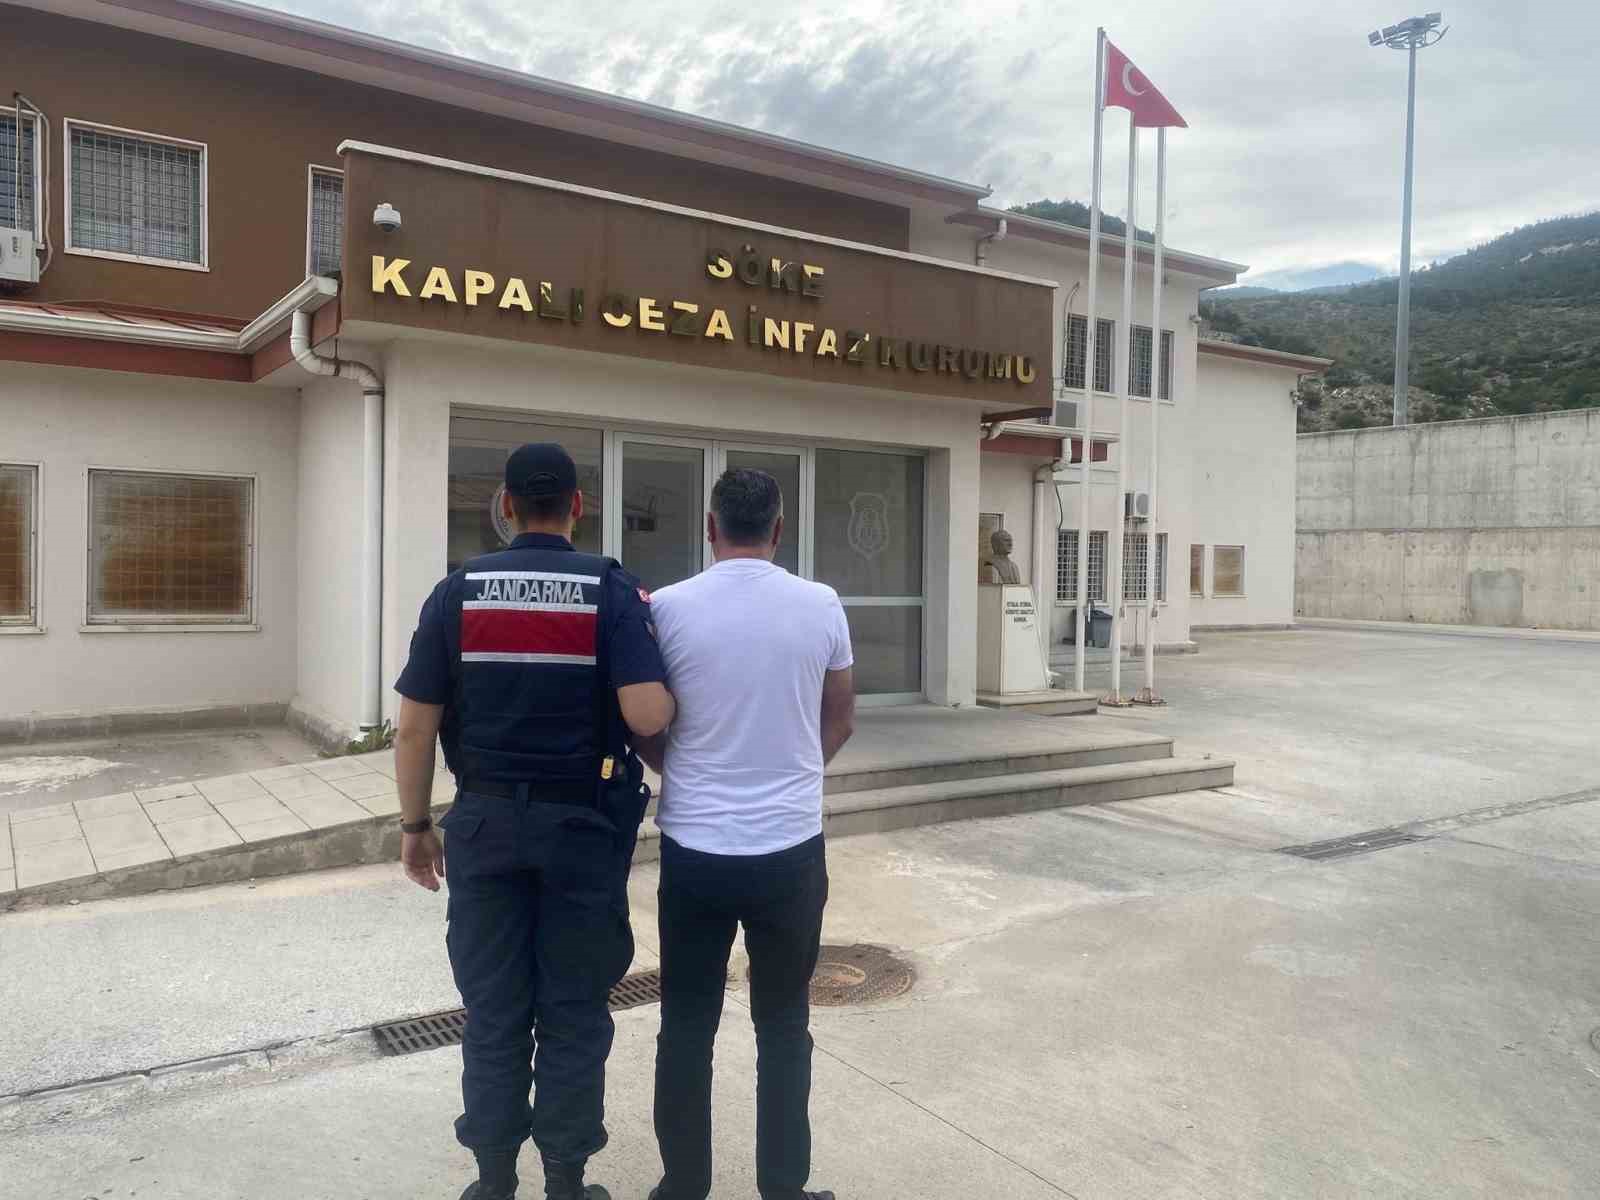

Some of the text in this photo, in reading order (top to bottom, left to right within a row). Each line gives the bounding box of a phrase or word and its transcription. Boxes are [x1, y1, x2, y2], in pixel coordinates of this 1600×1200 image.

[706, 244, 824, 297] SÖKE
[371, 255, 1036, 384] KAPALI CEZA İNFAZ KURUMU
[477, 579, 584, 604] JANDARMA
